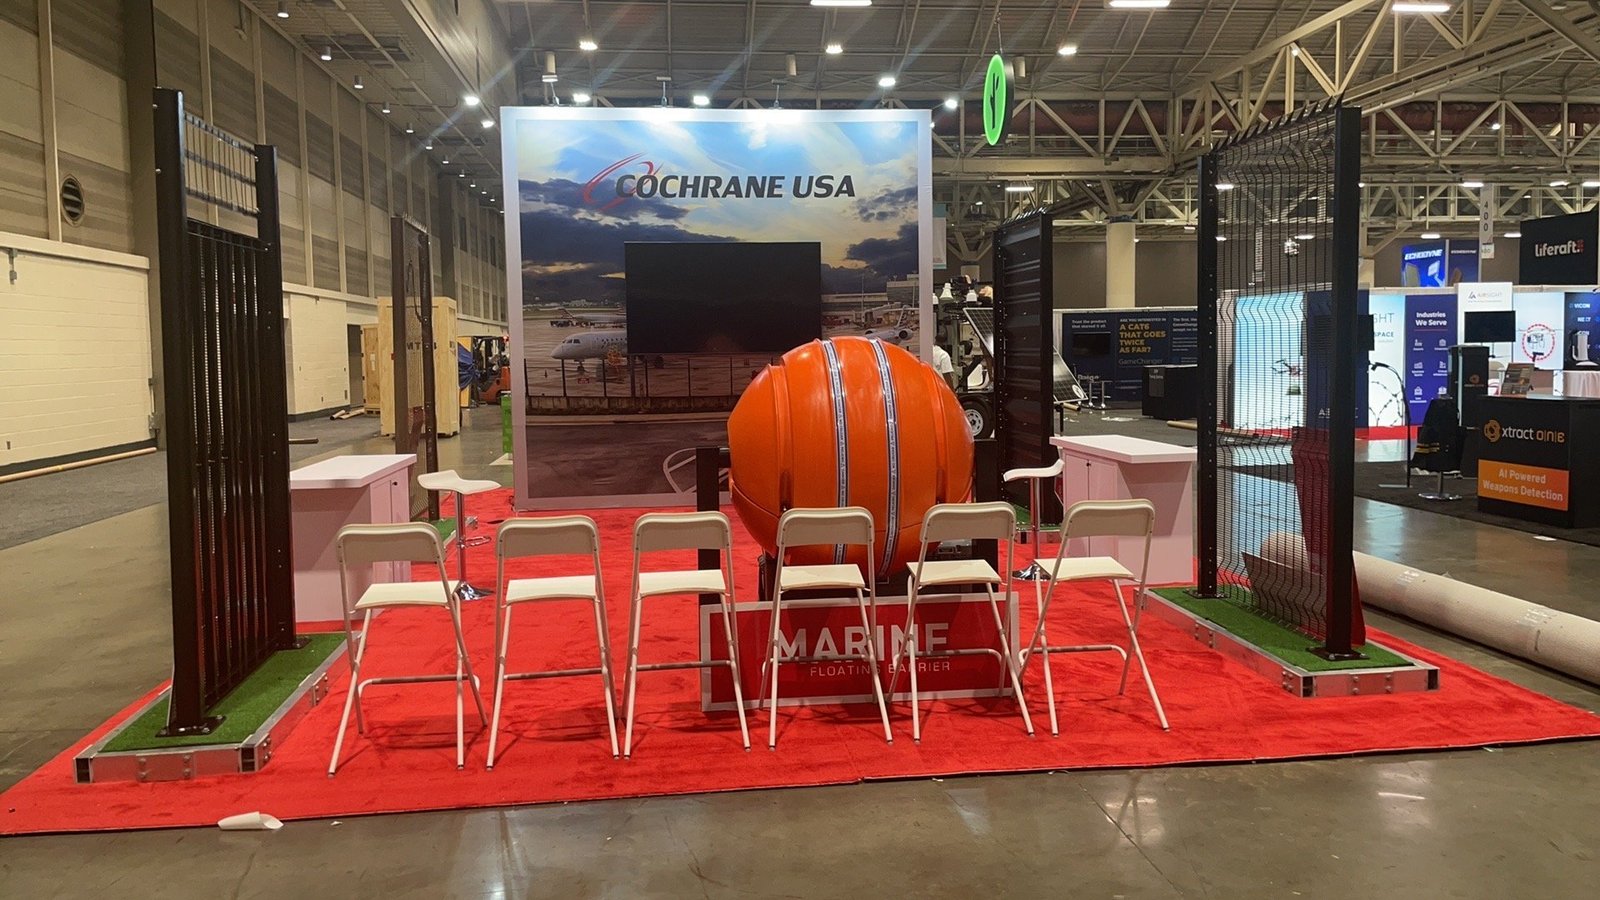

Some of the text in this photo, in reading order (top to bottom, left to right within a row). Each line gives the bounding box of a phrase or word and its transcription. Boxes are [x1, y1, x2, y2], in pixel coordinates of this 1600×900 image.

[615, 174, 856, 199] COCHRANE USA
[1404, 249, 1443, 260] ECHODYNE
[1502, 426, 1534, 440] xtract
[1498, 468, 1546, 484] AI Powered
[1482, 480, 1563, 501] Weapons Detection
[777, 623, 949, 664] MARINE
[888, 661, 950, 674] BARIER
